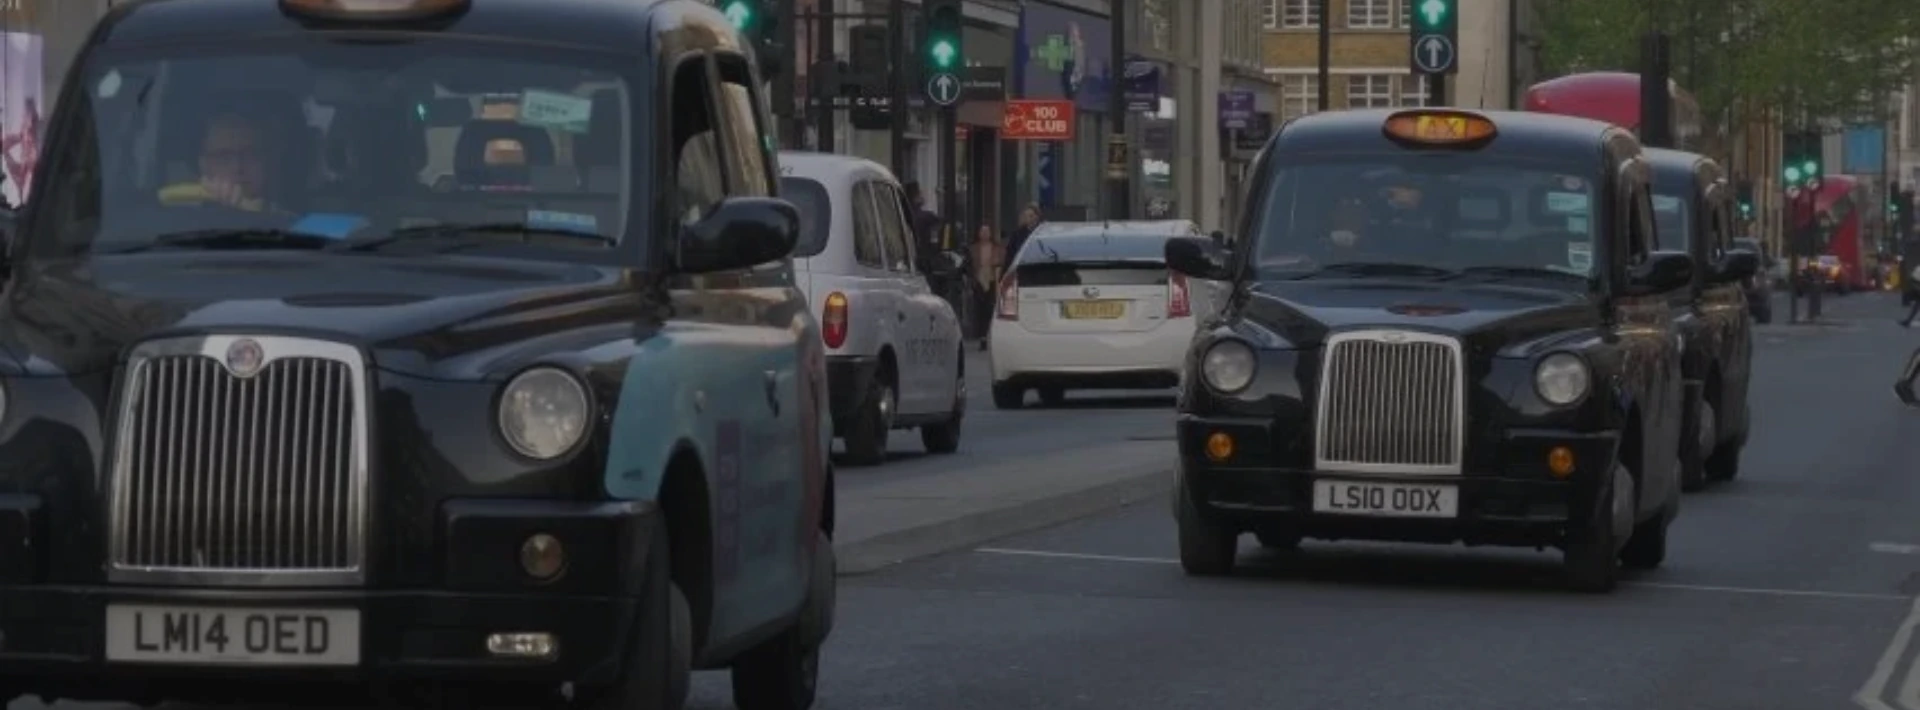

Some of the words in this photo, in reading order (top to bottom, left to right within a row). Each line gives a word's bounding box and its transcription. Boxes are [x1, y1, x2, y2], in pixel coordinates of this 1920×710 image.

[1033, 106, 1057, 118] 100
[1026, 119, 1067, 132] CLUB
[1330, 485, 1385, 509] LS10
[133, 611, 230, 654] LM14
[244, 613, 330, 655] OED
